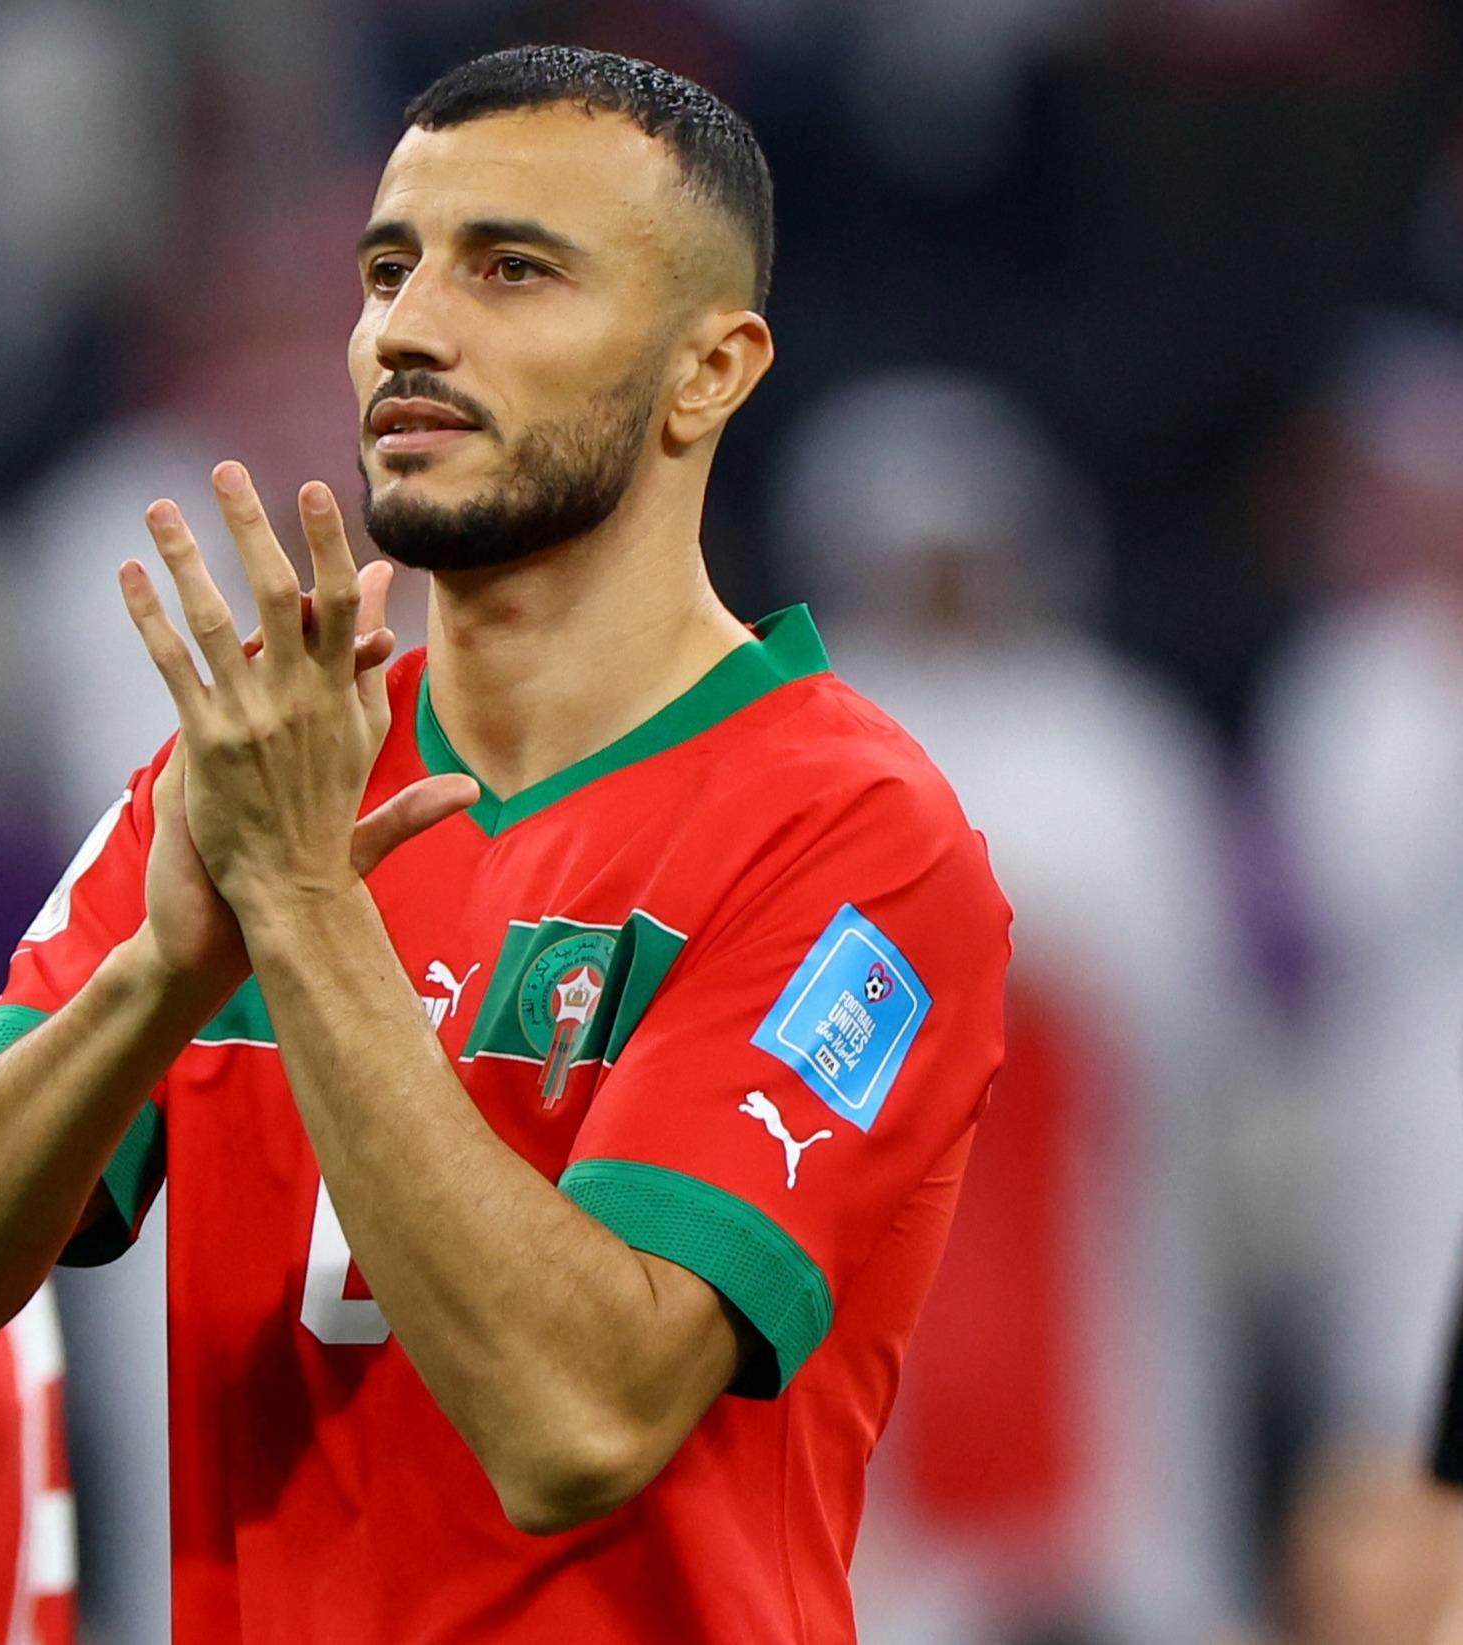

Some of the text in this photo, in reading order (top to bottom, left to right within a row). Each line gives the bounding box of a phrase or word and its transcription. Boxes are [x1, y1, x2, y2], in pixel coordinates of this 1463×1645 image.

[828, 1002, 869, 1054] UNITES
[838, 989, 877, 1038] FOOTBALL
[815, 1020, 861, 1072] the World
[818, 1050, 836, 1071] FIFA
